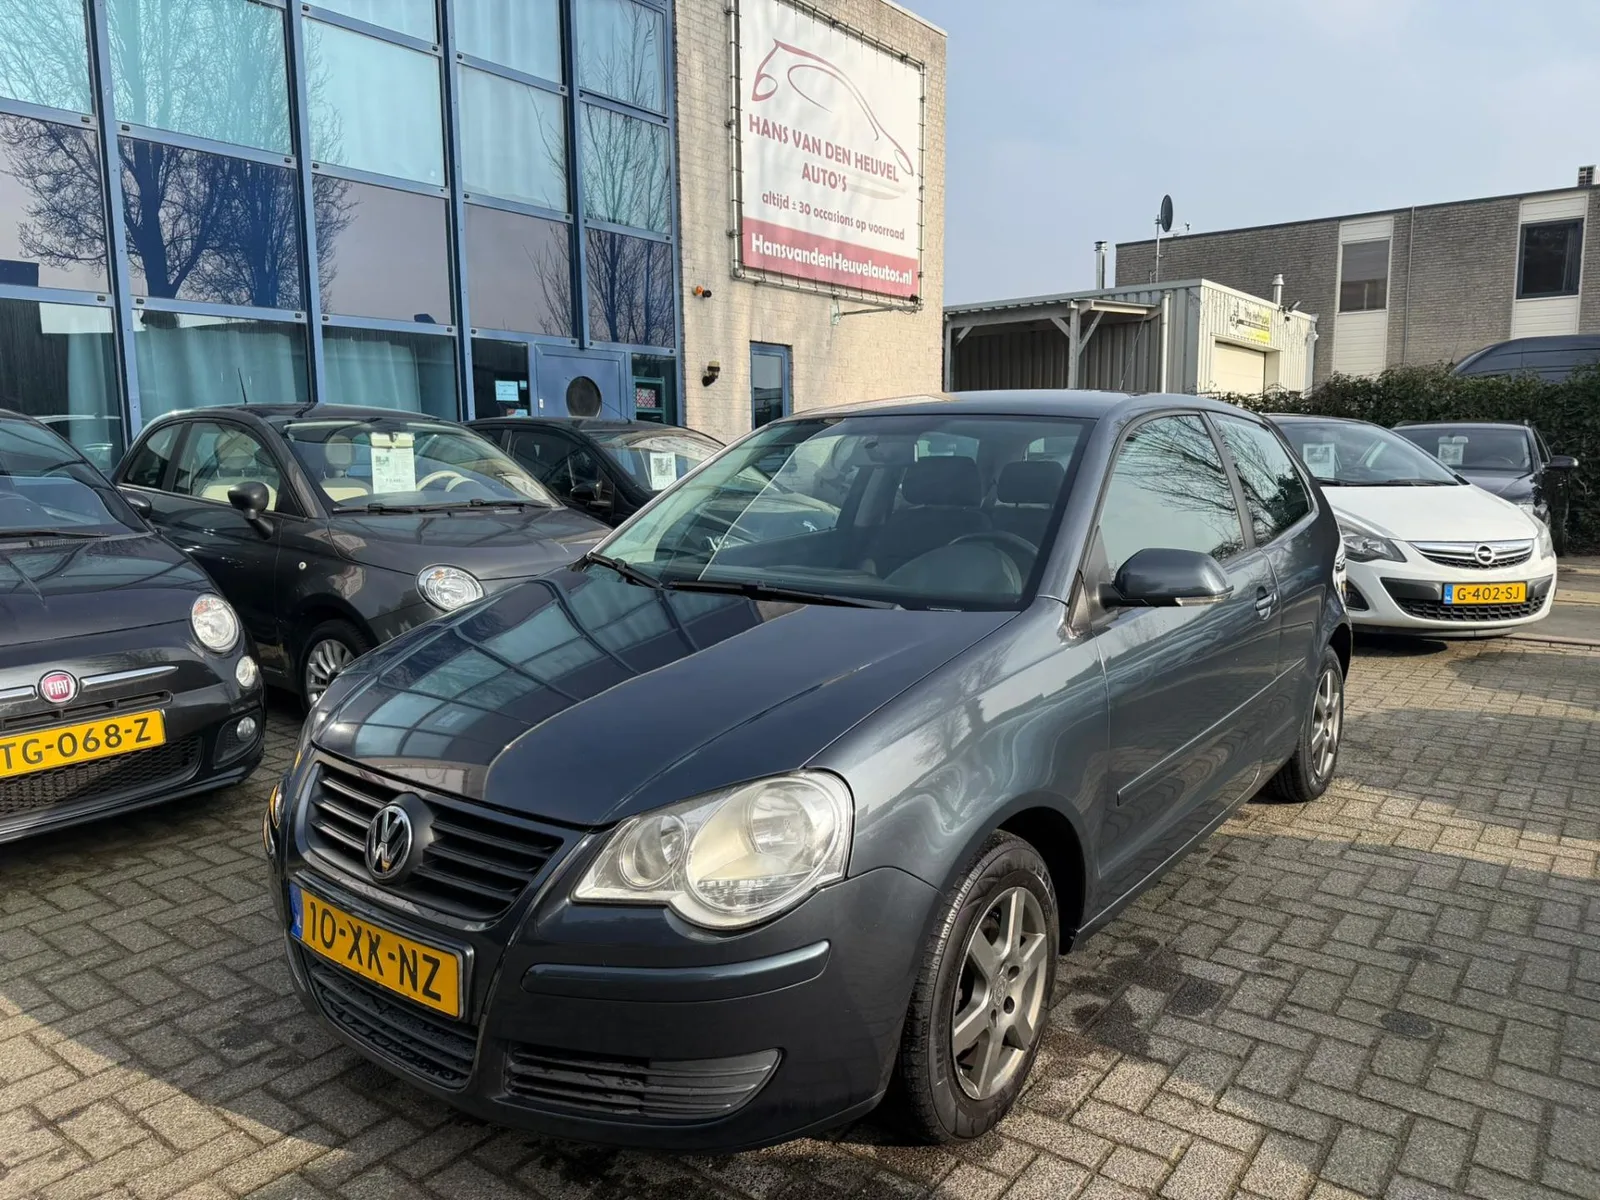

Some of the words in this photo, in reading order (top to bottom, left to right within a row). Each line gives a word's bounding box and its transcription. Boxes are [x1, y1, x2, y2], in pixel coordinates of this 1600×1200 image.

[749, 114, 788, 144] HANS
[793, 130, 821, 156] VAN
[825, 142, 851, 166] DEN
[855, 152, 899, 182] HEUVEL
[802, 163, 847, 192] AUTO'S
[762, 191, 789, 210] altijd
[799, 201, 811, 215] 30
[813, 207, 853, 227] occasions
[855, 219, 867, 232] op
[868, 223, 905, 240] voorraad
[752, 233, 912, 285] HansvandenHeuvelautos.nl
[1457, 587, 1519, 600] G-402-SJ
[49, 680, 68, 695] FIAT
[0, 717, 151, 769] TG-068-Z
[310, 901, 441, 1002] 10-XK-NZ
